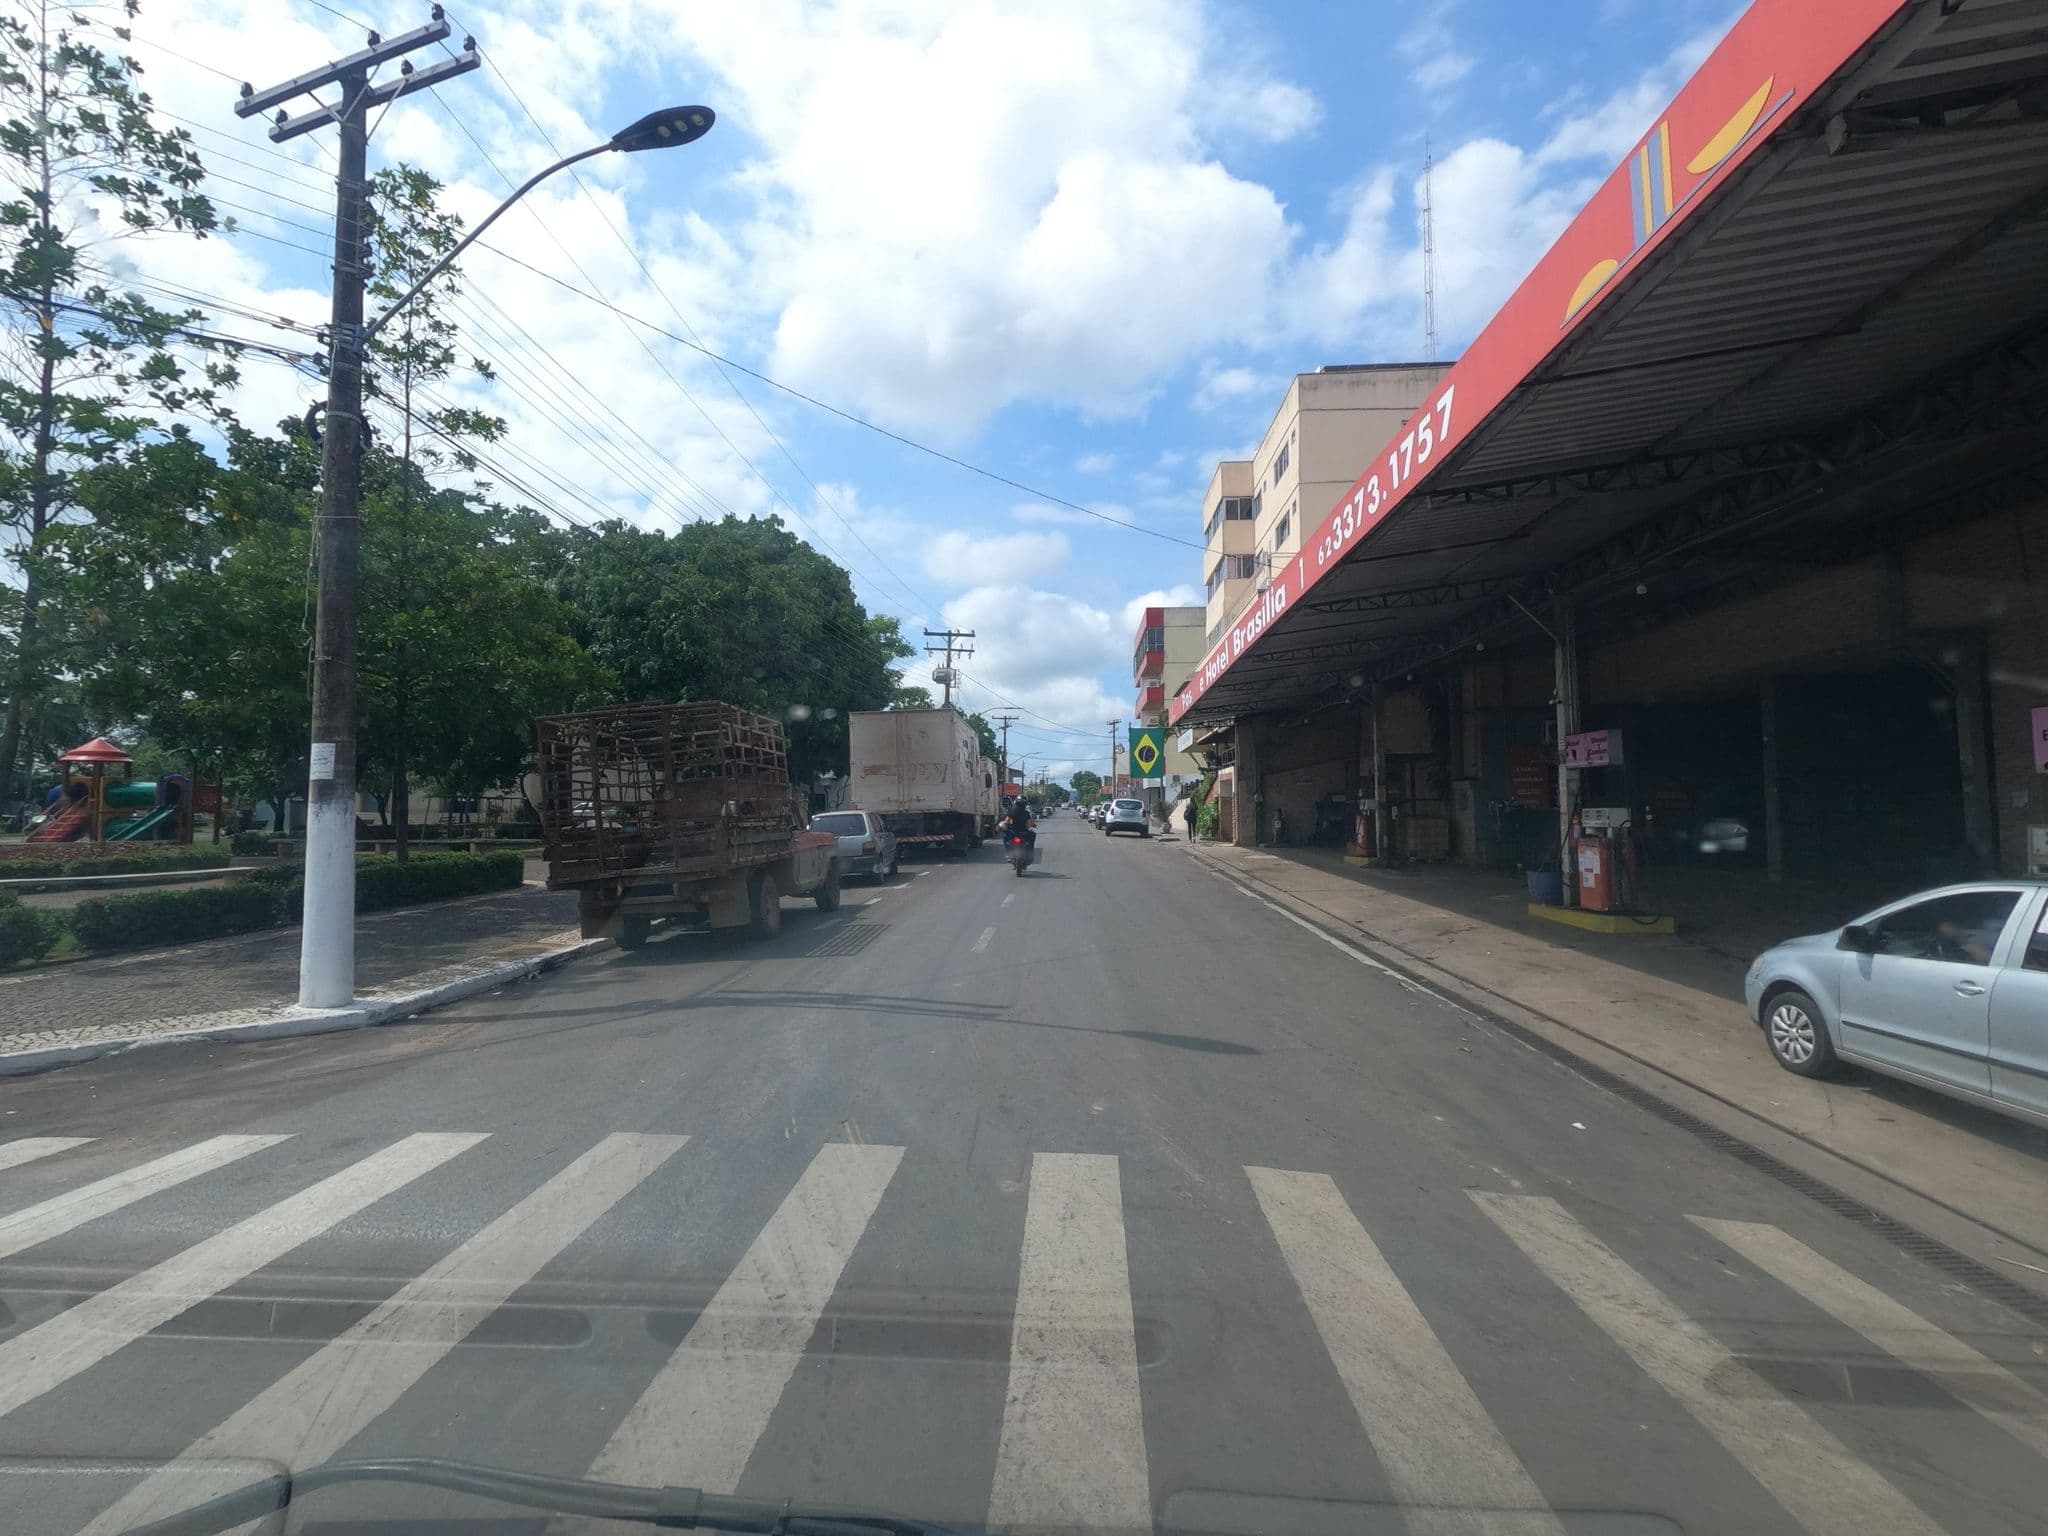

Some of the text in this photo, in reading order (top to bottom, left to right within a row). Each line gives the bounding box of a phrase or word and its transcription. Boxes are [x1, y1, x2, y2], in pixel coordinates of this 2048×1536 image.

[1199, 676, 1204, 691] e
[1205, 639, 1229, 685] Hotel
[1233, 583, 1286, 656] Brasília
